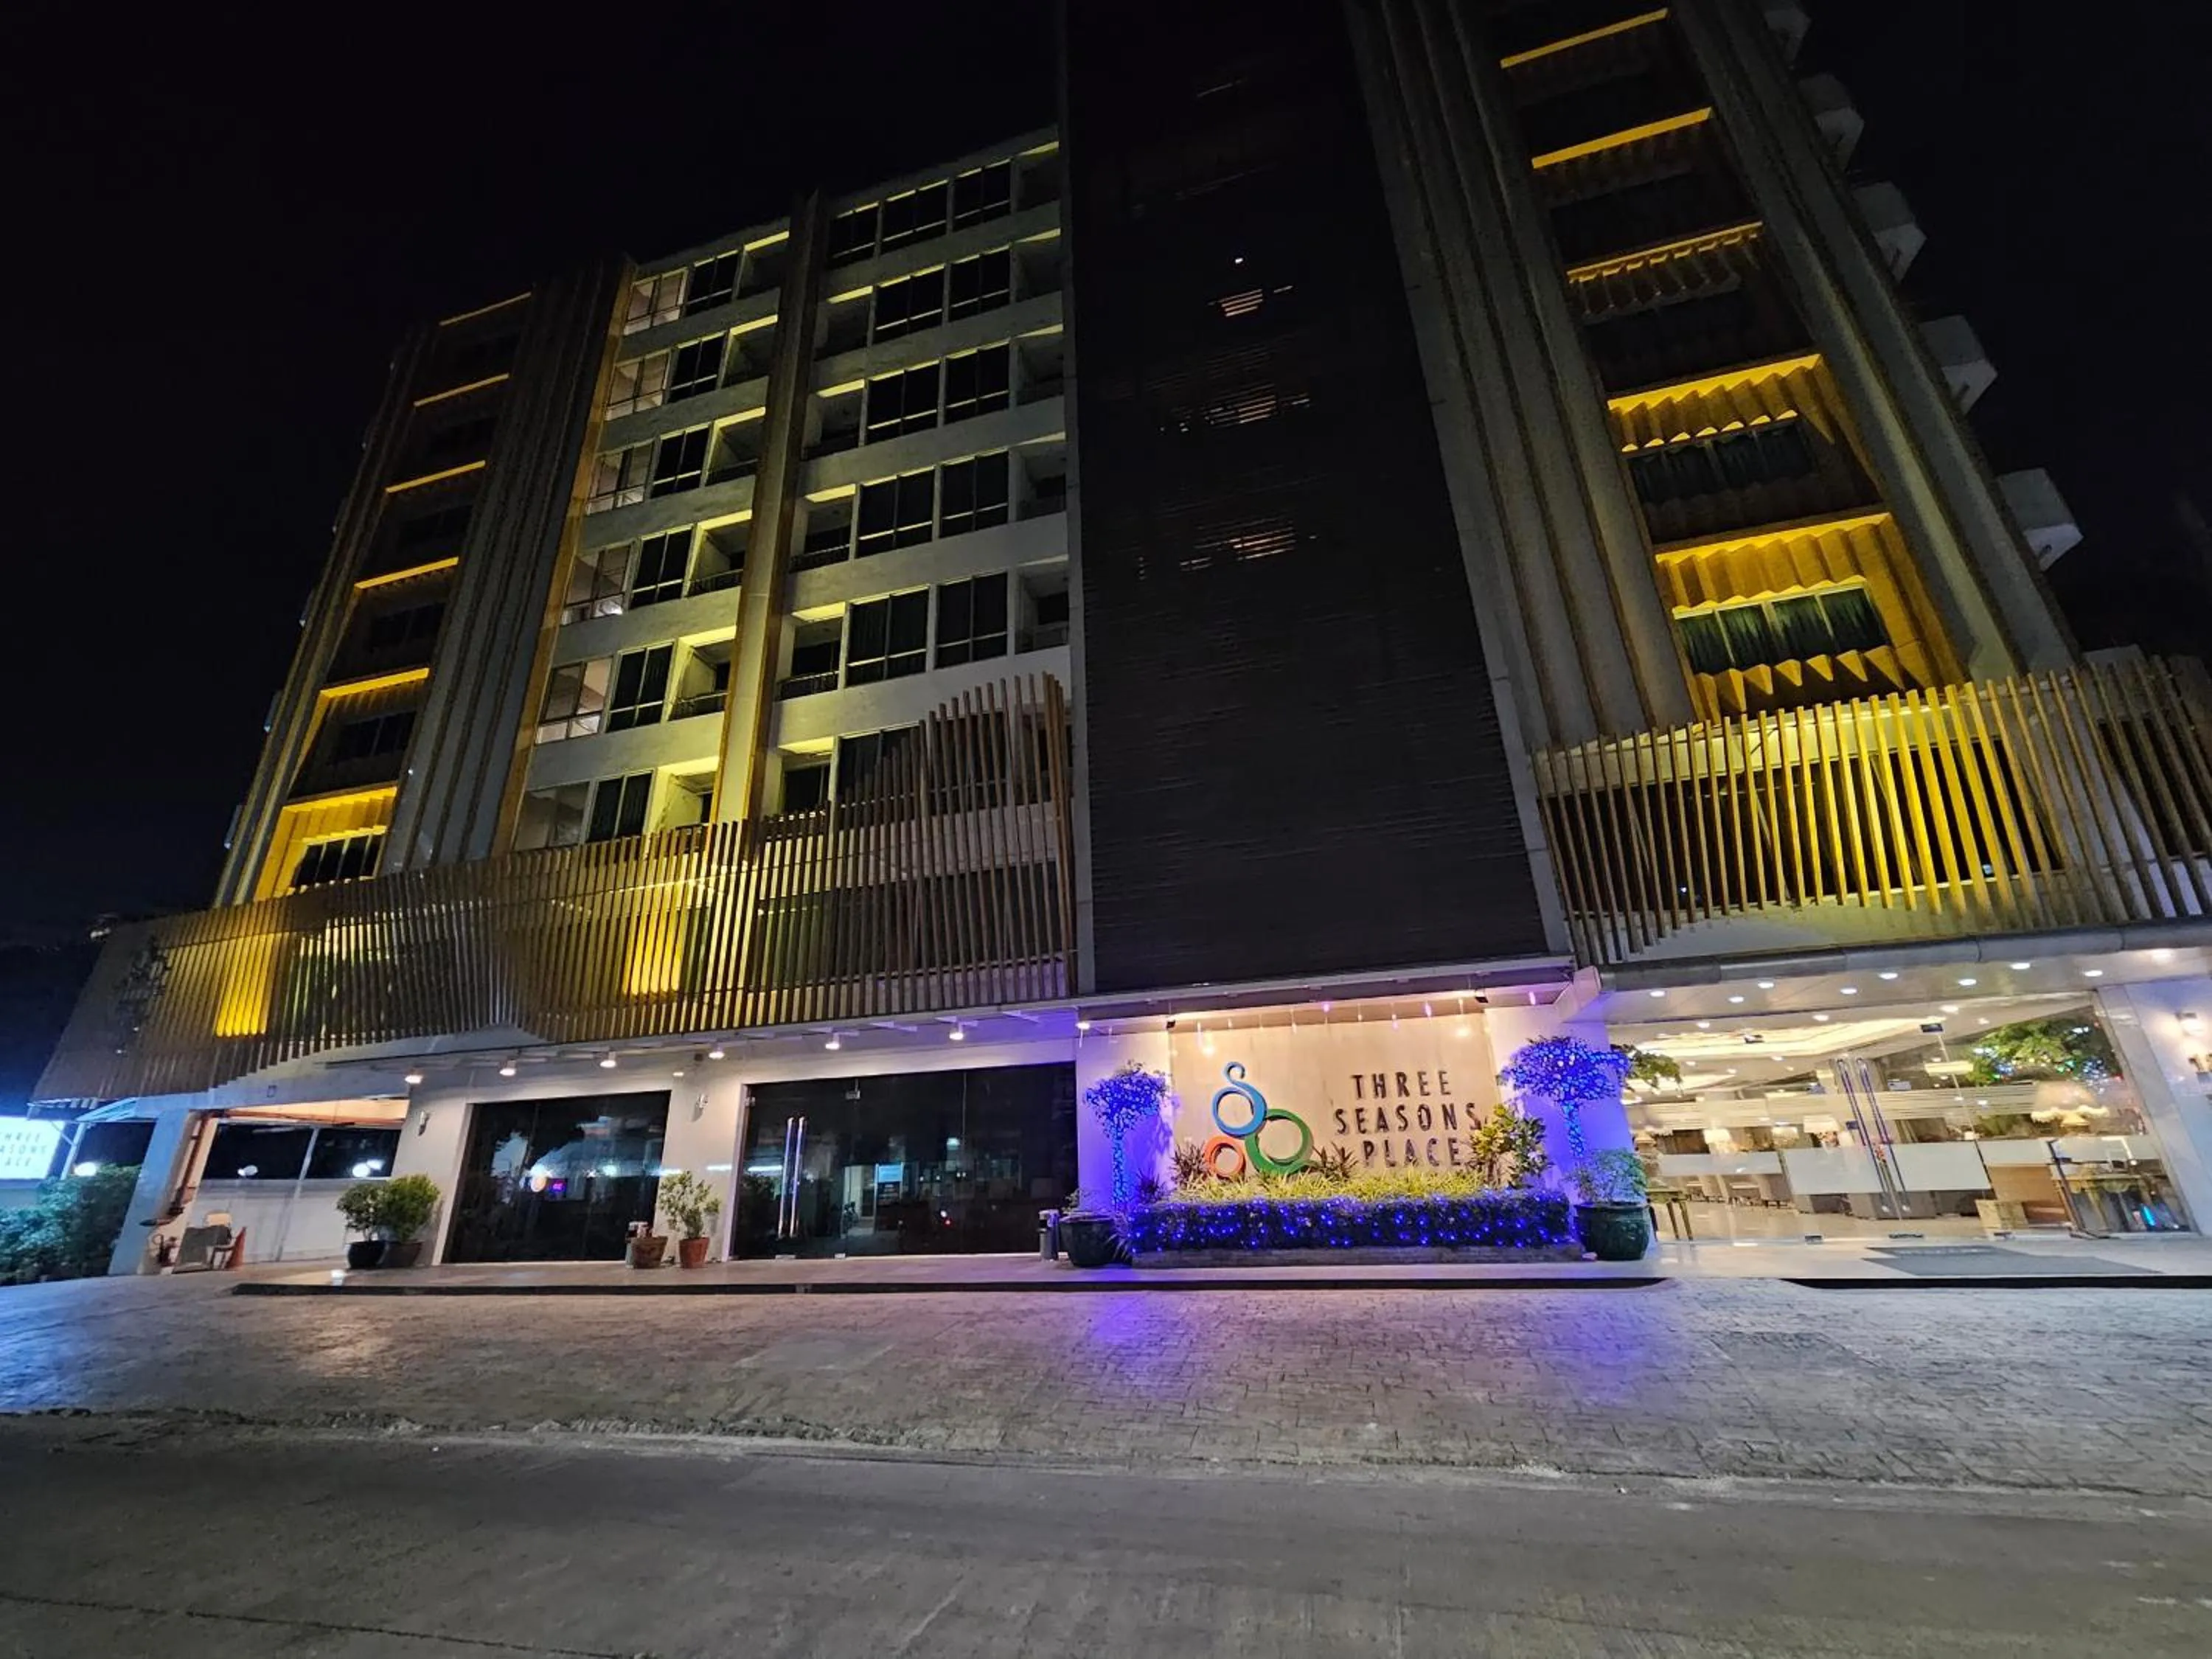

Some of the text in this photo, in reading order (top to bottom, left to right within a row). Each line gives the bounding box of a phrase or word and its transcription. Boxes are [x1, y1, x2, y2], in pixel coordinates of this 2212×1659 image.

[1351, 1071, 1452, 1099] THREE
[1334, 1102, 1482, 1135] SEASONS
[0, 1132, 41, 1142] HREE
[1363, 1138, 1462, 1169] PLACE
